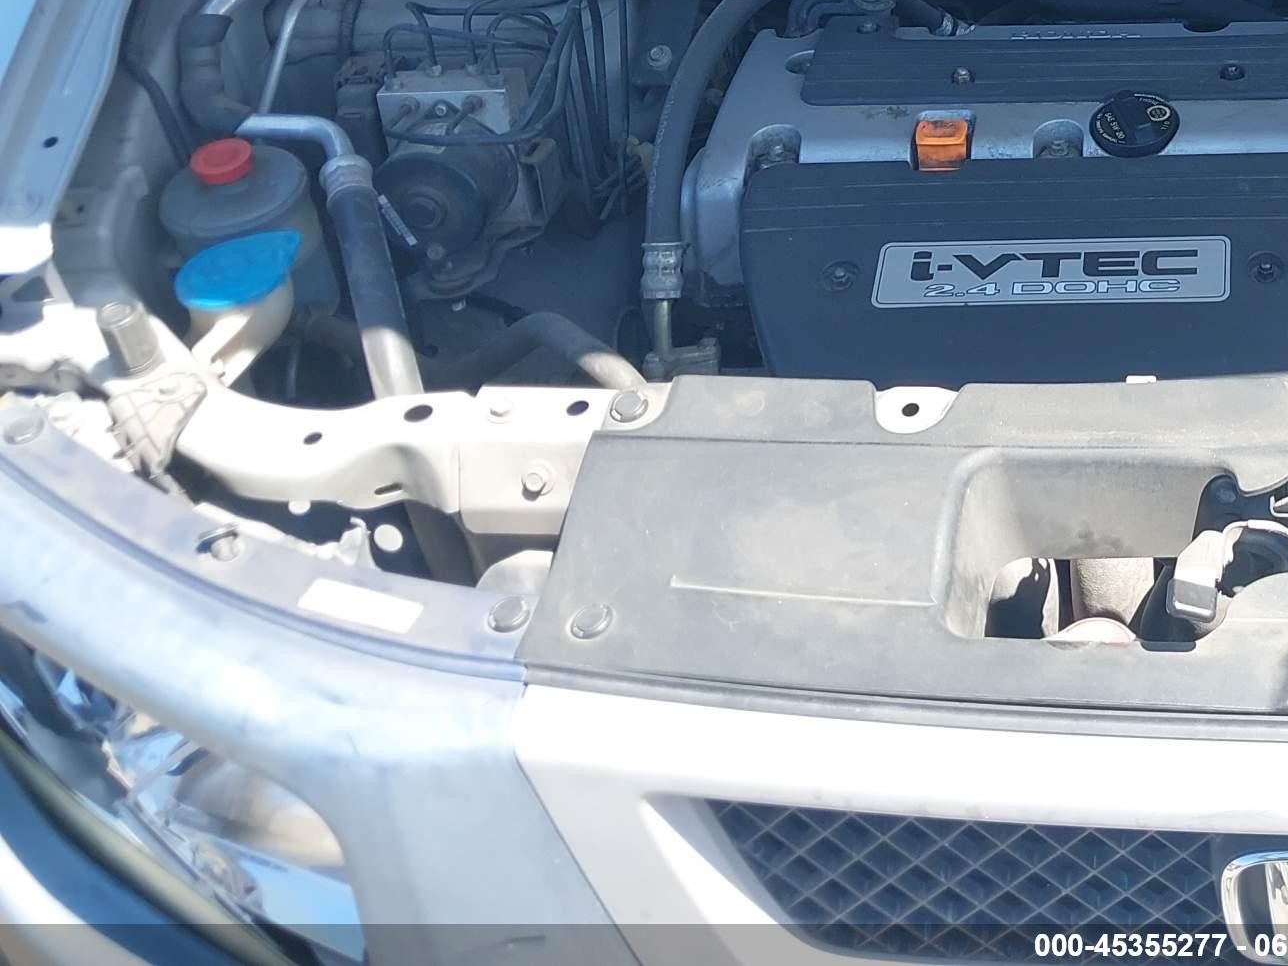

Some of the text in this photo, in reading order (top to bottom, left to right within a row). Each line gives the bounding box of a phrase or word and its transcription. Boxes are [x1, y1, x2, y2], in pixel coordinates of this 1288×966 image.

[910, 250, 1198, 280] i-VTEC
[923, 278, 1181, 297] 2.4 DOHC
